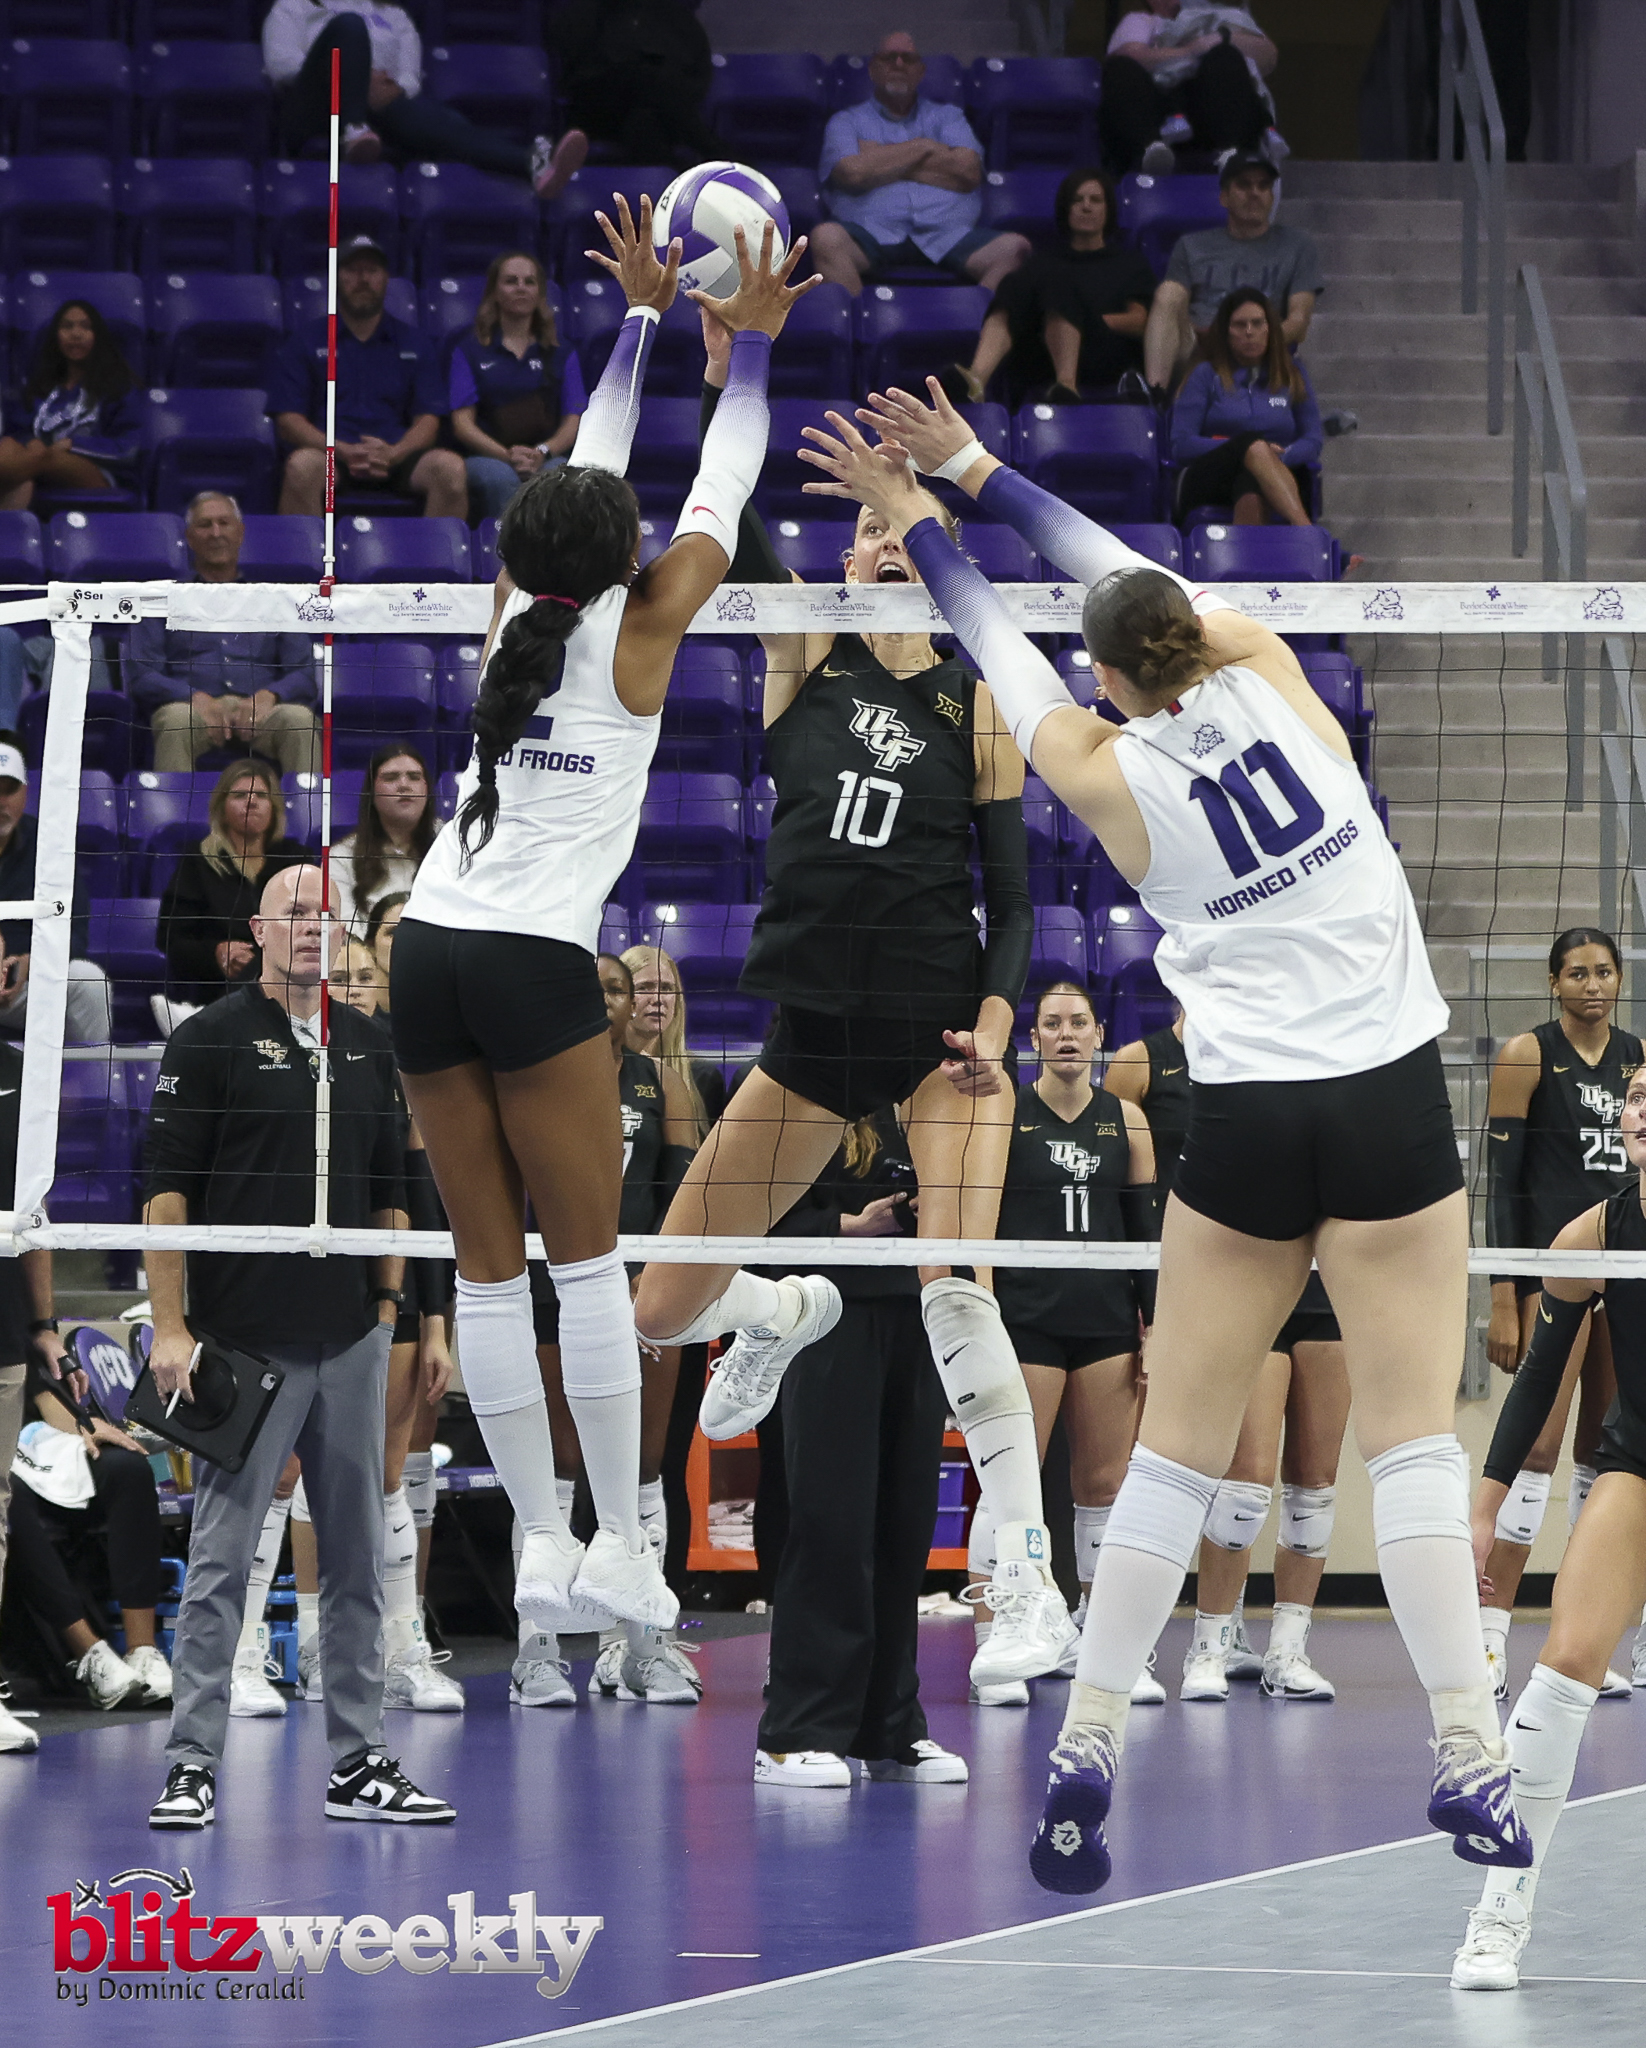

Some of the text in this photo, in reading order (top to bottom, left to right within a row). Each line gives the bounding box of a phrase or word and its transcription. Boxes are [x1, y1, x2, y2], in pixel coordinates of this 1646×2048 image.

[849, 698, 926, 772] UCF
[519, 748, 596, 775] FROGS
[829, 770, 904, 848] 10
[1189, 739, 1325, 880] 10
[1204, 819, 1359, 920] HORNED FROGS
[253, 1039, 288, 1063] UCF
[1576, 1083, 1625, 1123] UCF
[1045, 1141, 1101, 1181] UCF
[1580, 1128, 1627, 1173] 25
[1061, 1186, 1089, 1232] 11
